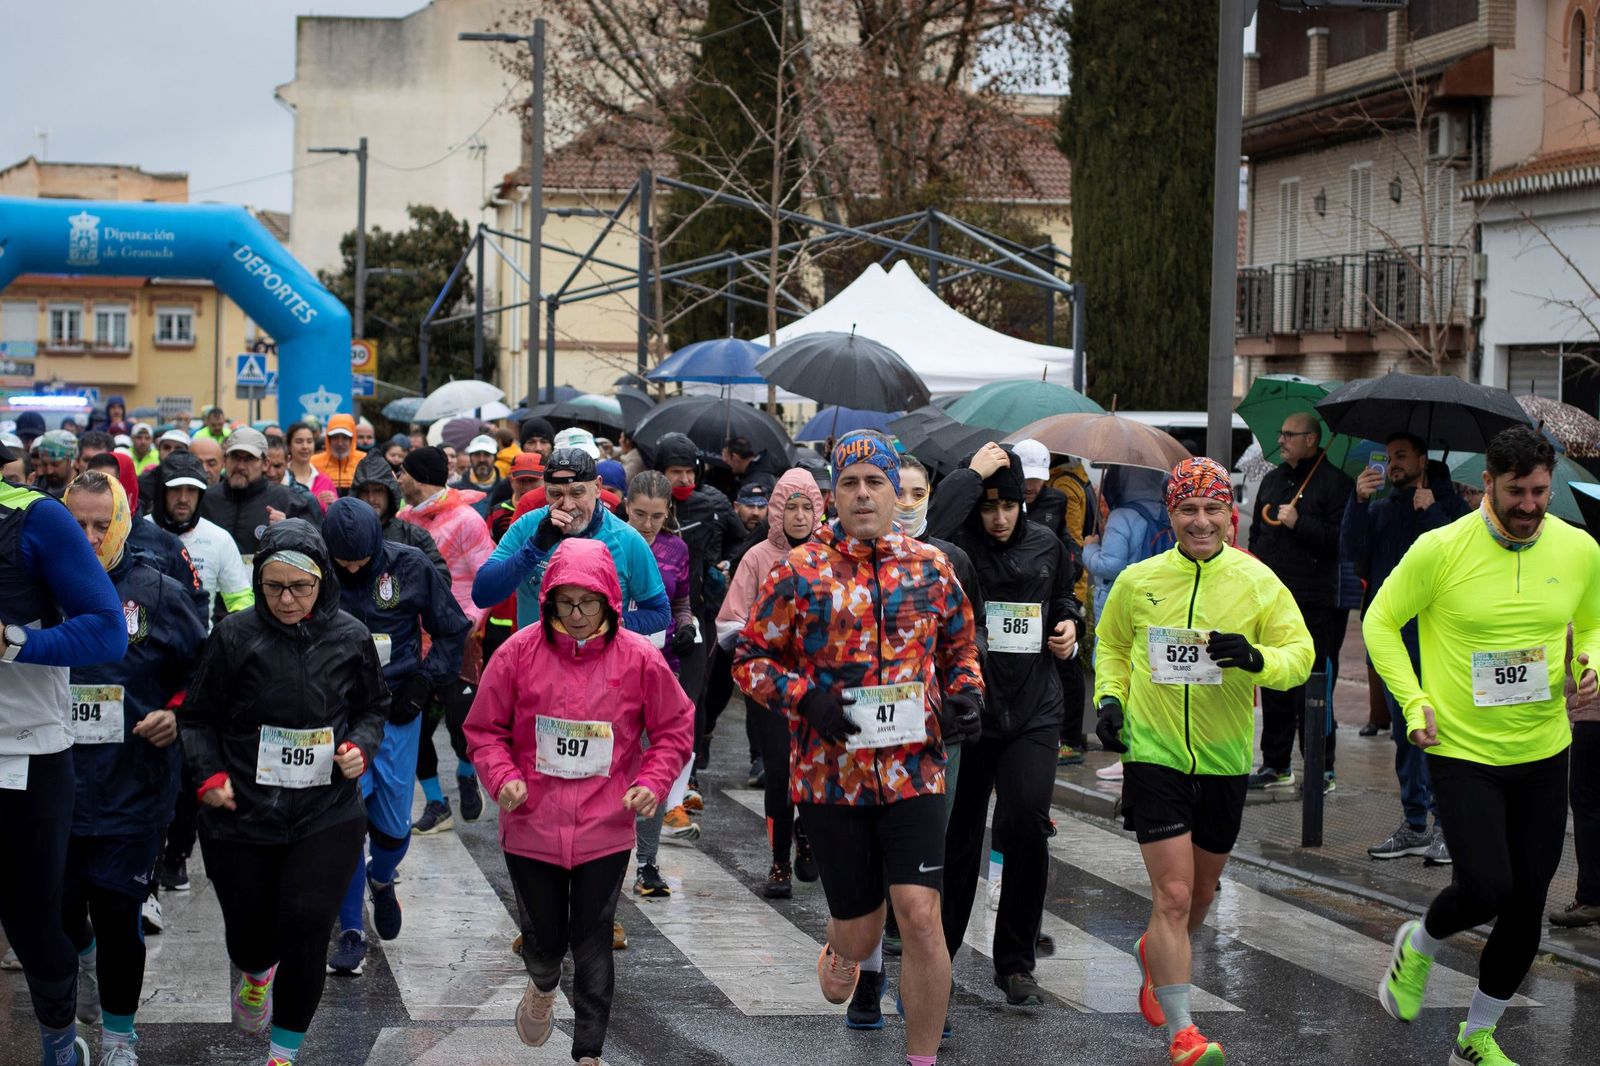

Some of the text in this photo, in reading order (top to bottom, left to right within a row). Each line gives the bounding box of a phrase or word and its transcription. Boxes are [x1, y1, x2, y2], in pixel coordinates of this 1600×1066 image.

[104, 227, 175, 243] Diputación
[103, 245, 174, 258] de Granada
[233, 245, 318, 324] DEPORTES
[1003, 617, 1029, 634] 585
[1166, 645, 1199, 663] 523
[1494, 665, 1528, 685] 592
[876, 703, 896, 723] 47
[281, 746, 315, 766] 595
[556, 737, 589, 757] 597
